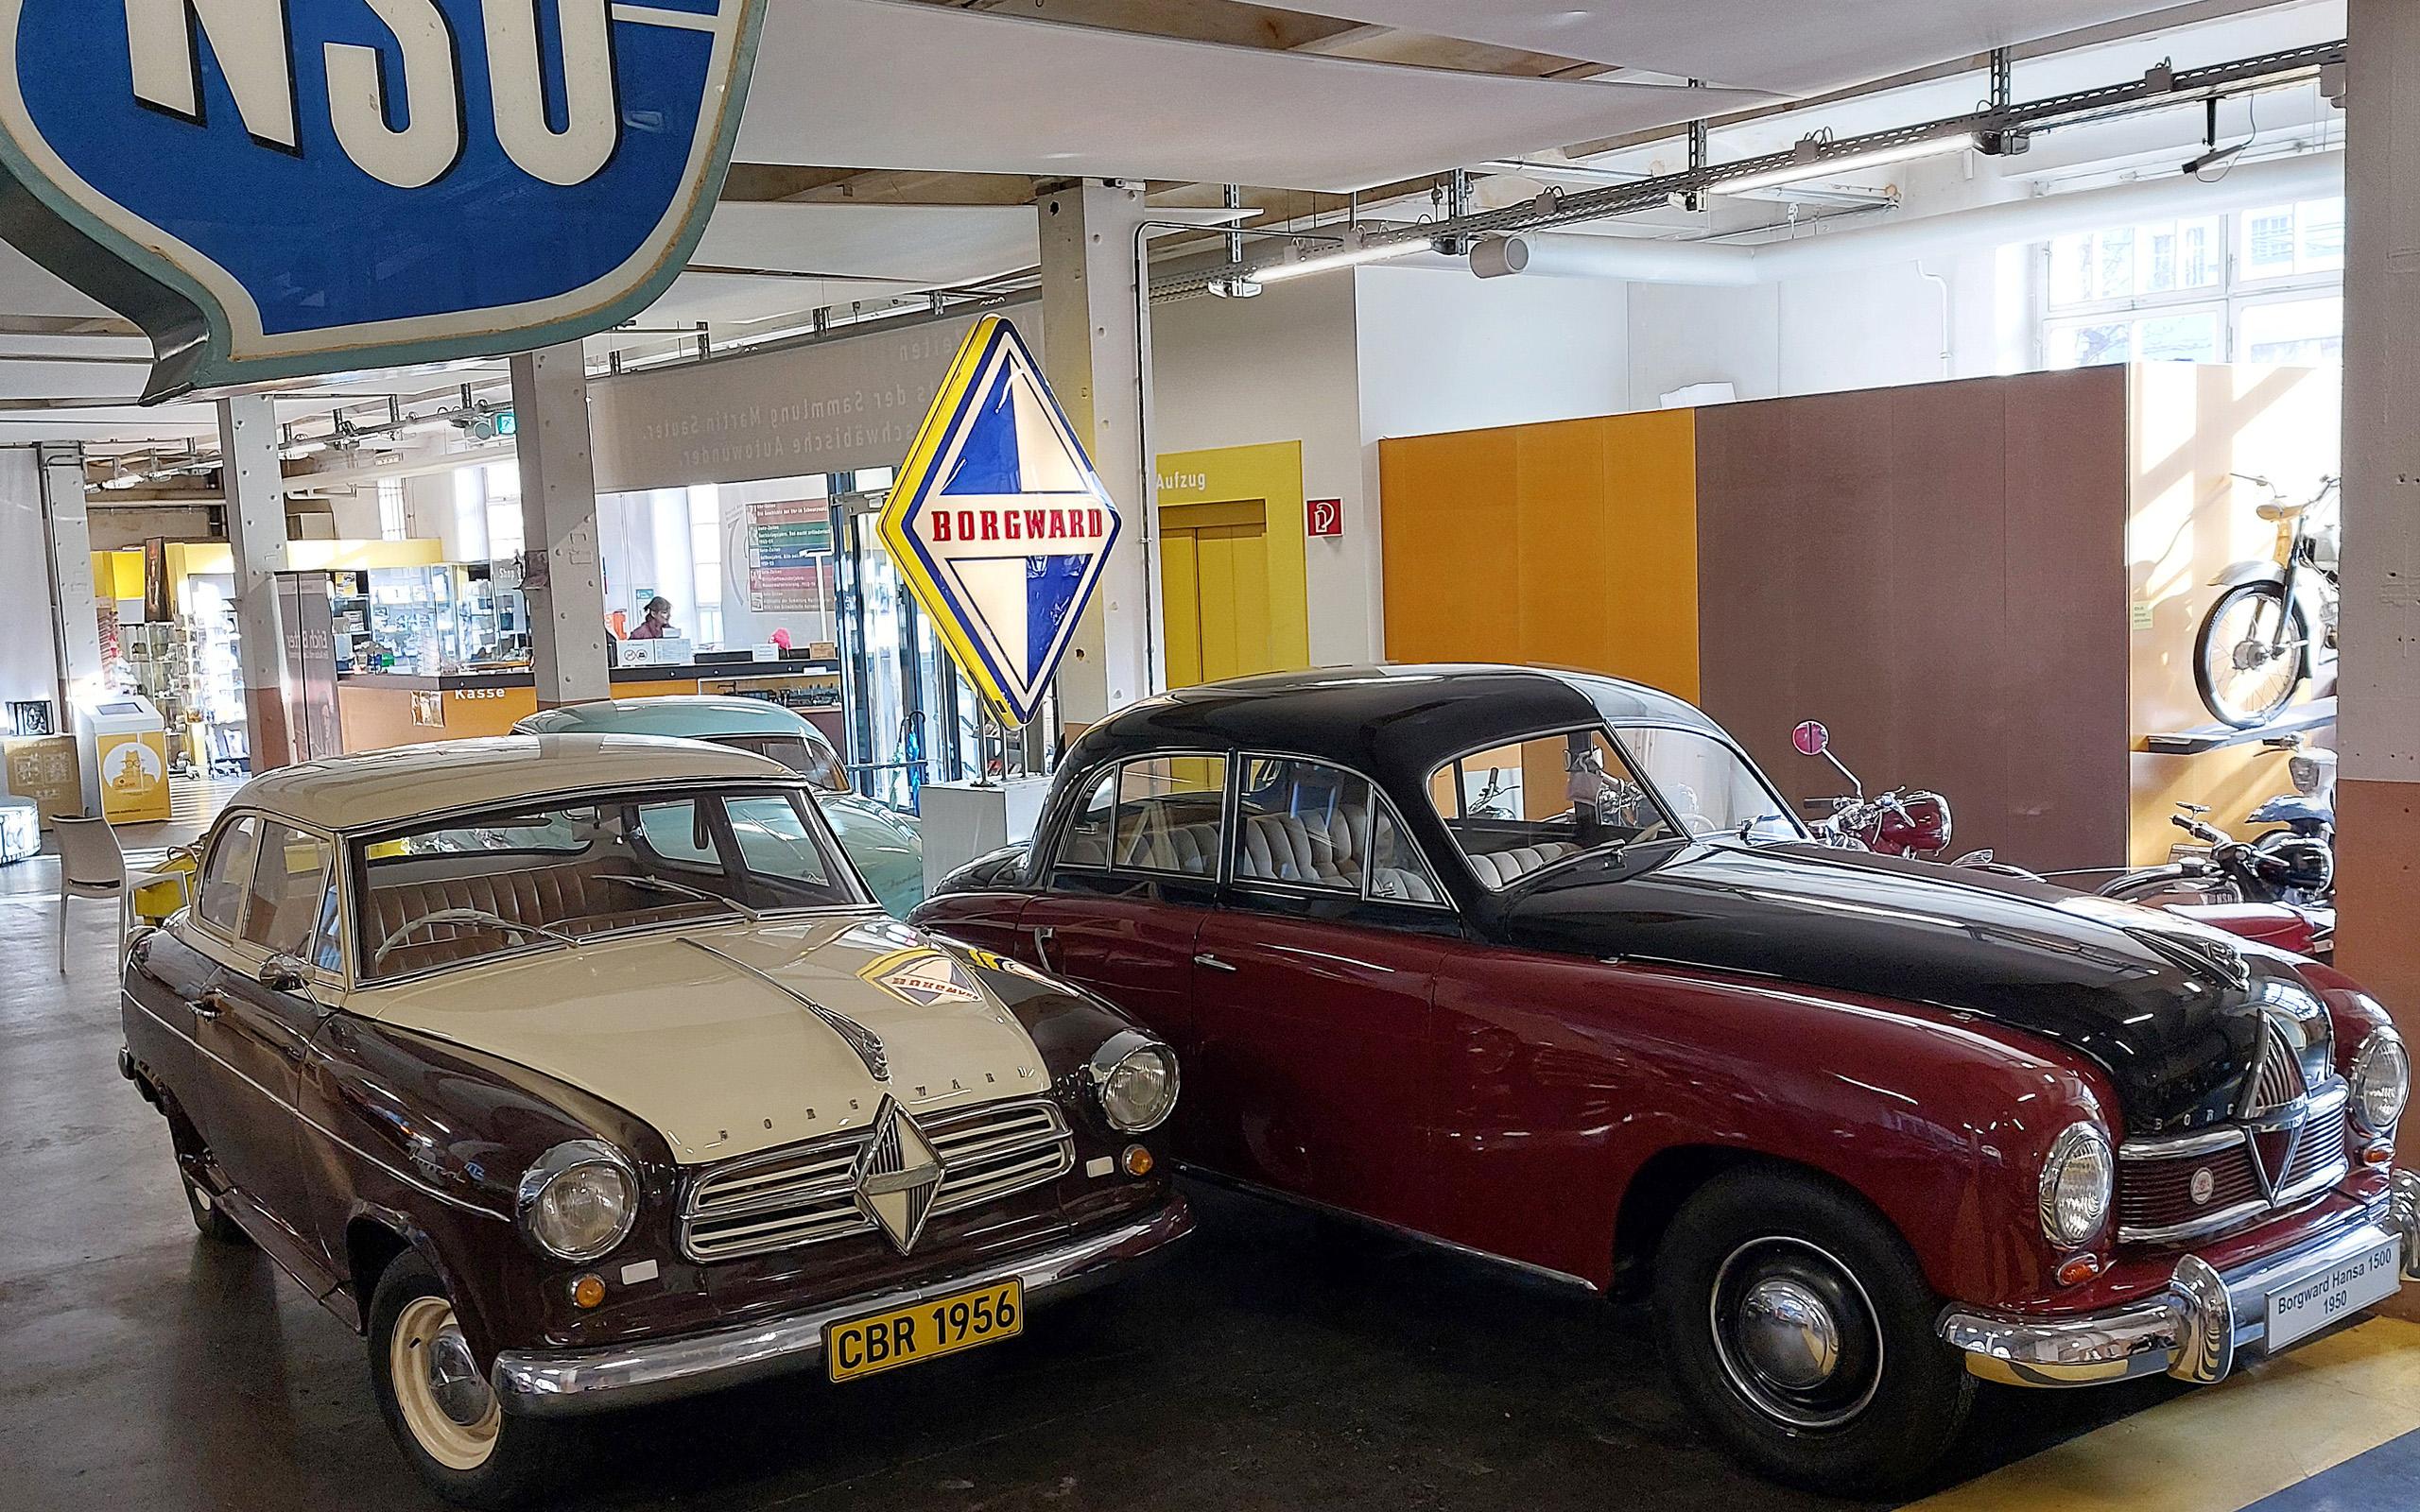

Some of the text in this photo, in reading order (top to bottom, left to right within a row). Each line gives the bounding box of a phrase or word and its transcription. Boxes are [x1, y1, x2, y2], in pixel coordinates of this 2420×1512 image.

[1156, 472, 1206, 491] Aufzug
[931, 508, 1103, 542] BORGWARD
[499, 567, 515, 581] Shop
[455, 687, 506, 700] Kasse
[2277, 1247, 2392, 1315] Borgward Hansa 1500
[2323, 1290, 2347, 1314] 1950
[838, 1289, 1016, 1369] CBR 1956
